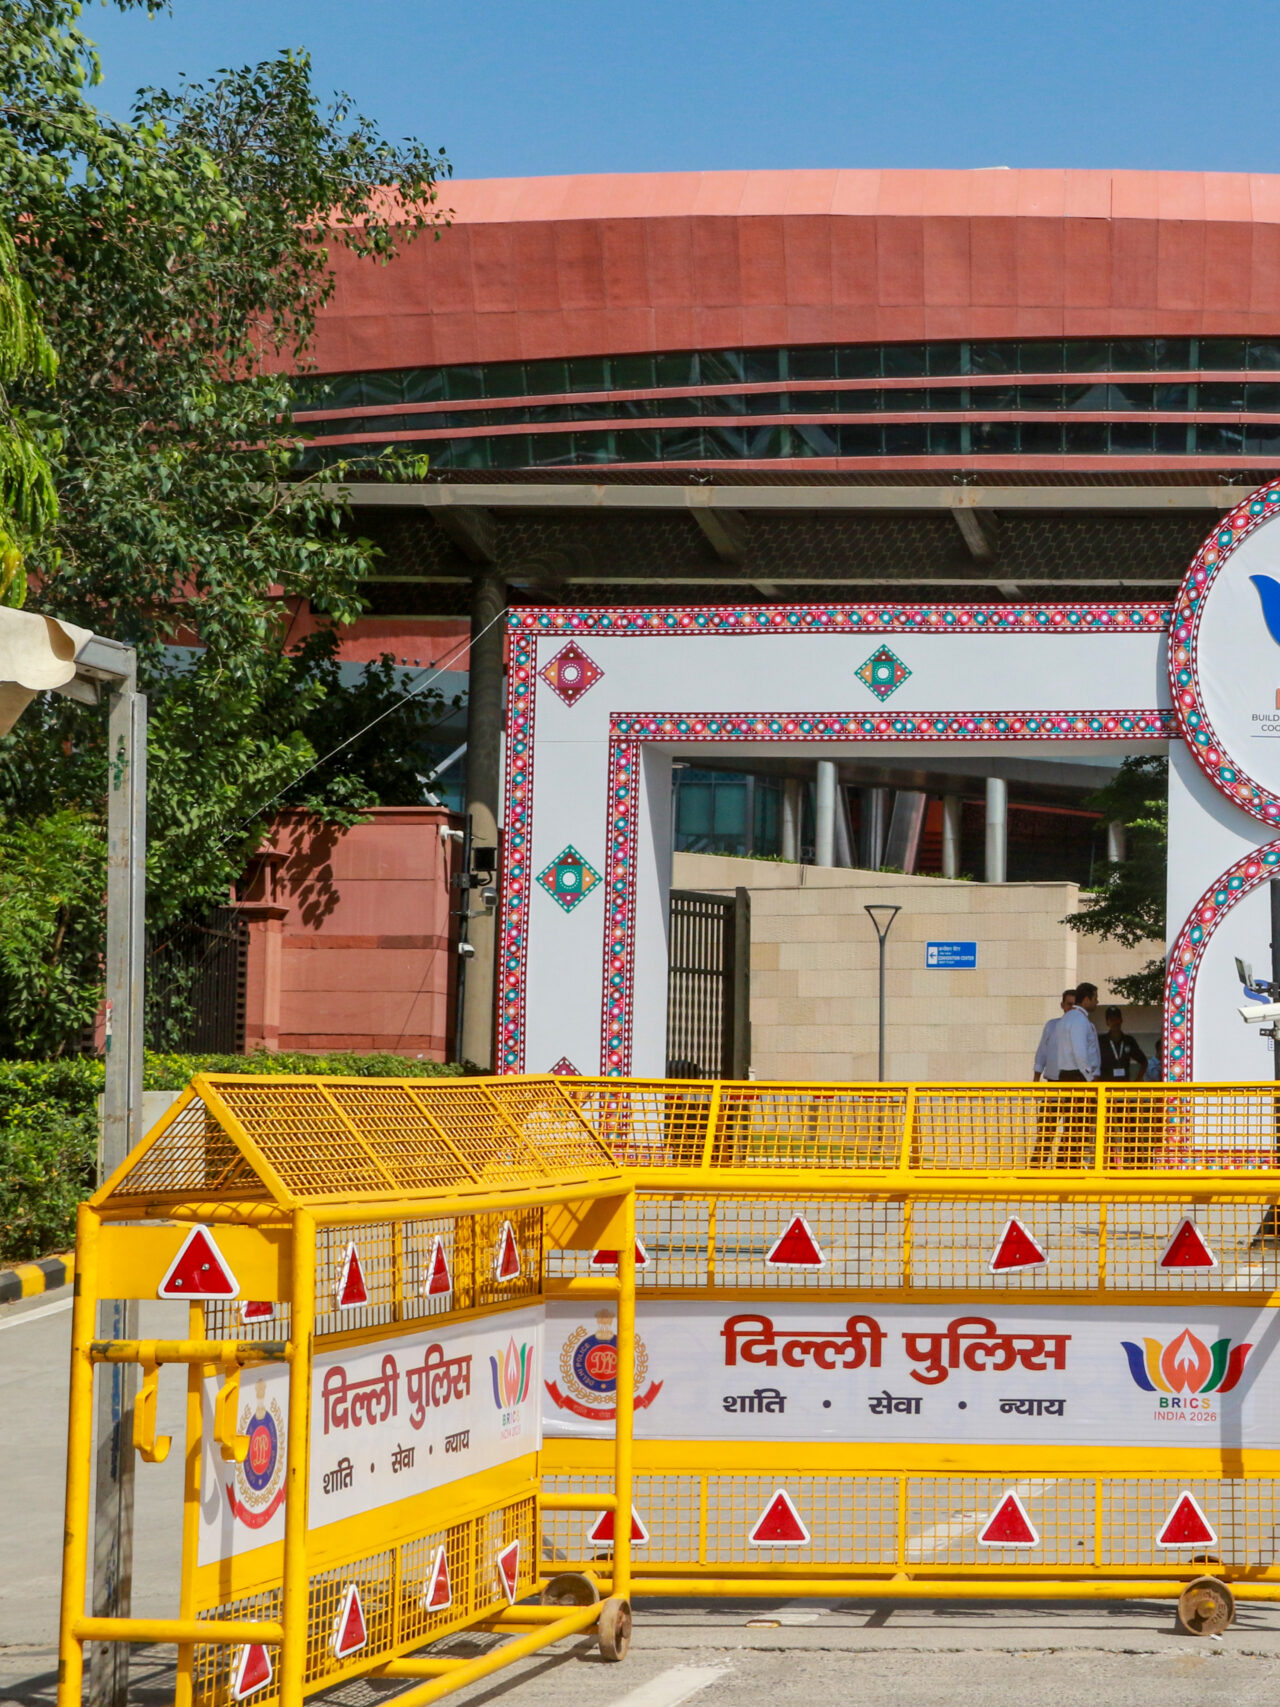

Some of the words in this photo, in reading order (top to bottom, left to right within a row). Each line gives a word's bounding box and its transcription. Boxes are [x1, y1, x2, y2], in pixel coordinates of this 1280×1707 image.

[720, 1314, 888, 1370] दिल्ली
[901, 1316, 1072, 1385] पुलिस
[321, 1365, 400, 1435] दिल्ली
[406, 1343, 472, 1430] पुलिस
[723, 1388, 787, 1413] शांति
[868, 1390, 923, 1415] सेवा
[999, 1399, 1066, 1416] न्याय
[1160, 1397, 1210, 1409] BRICS
[1154, 1411, 1186, 1421] INDIA
[1190, 1412, 1217, 1422] 2026
[391, 1443, 415, 1473] सेवा
[445, 1430, 470, 1454] न्याय
